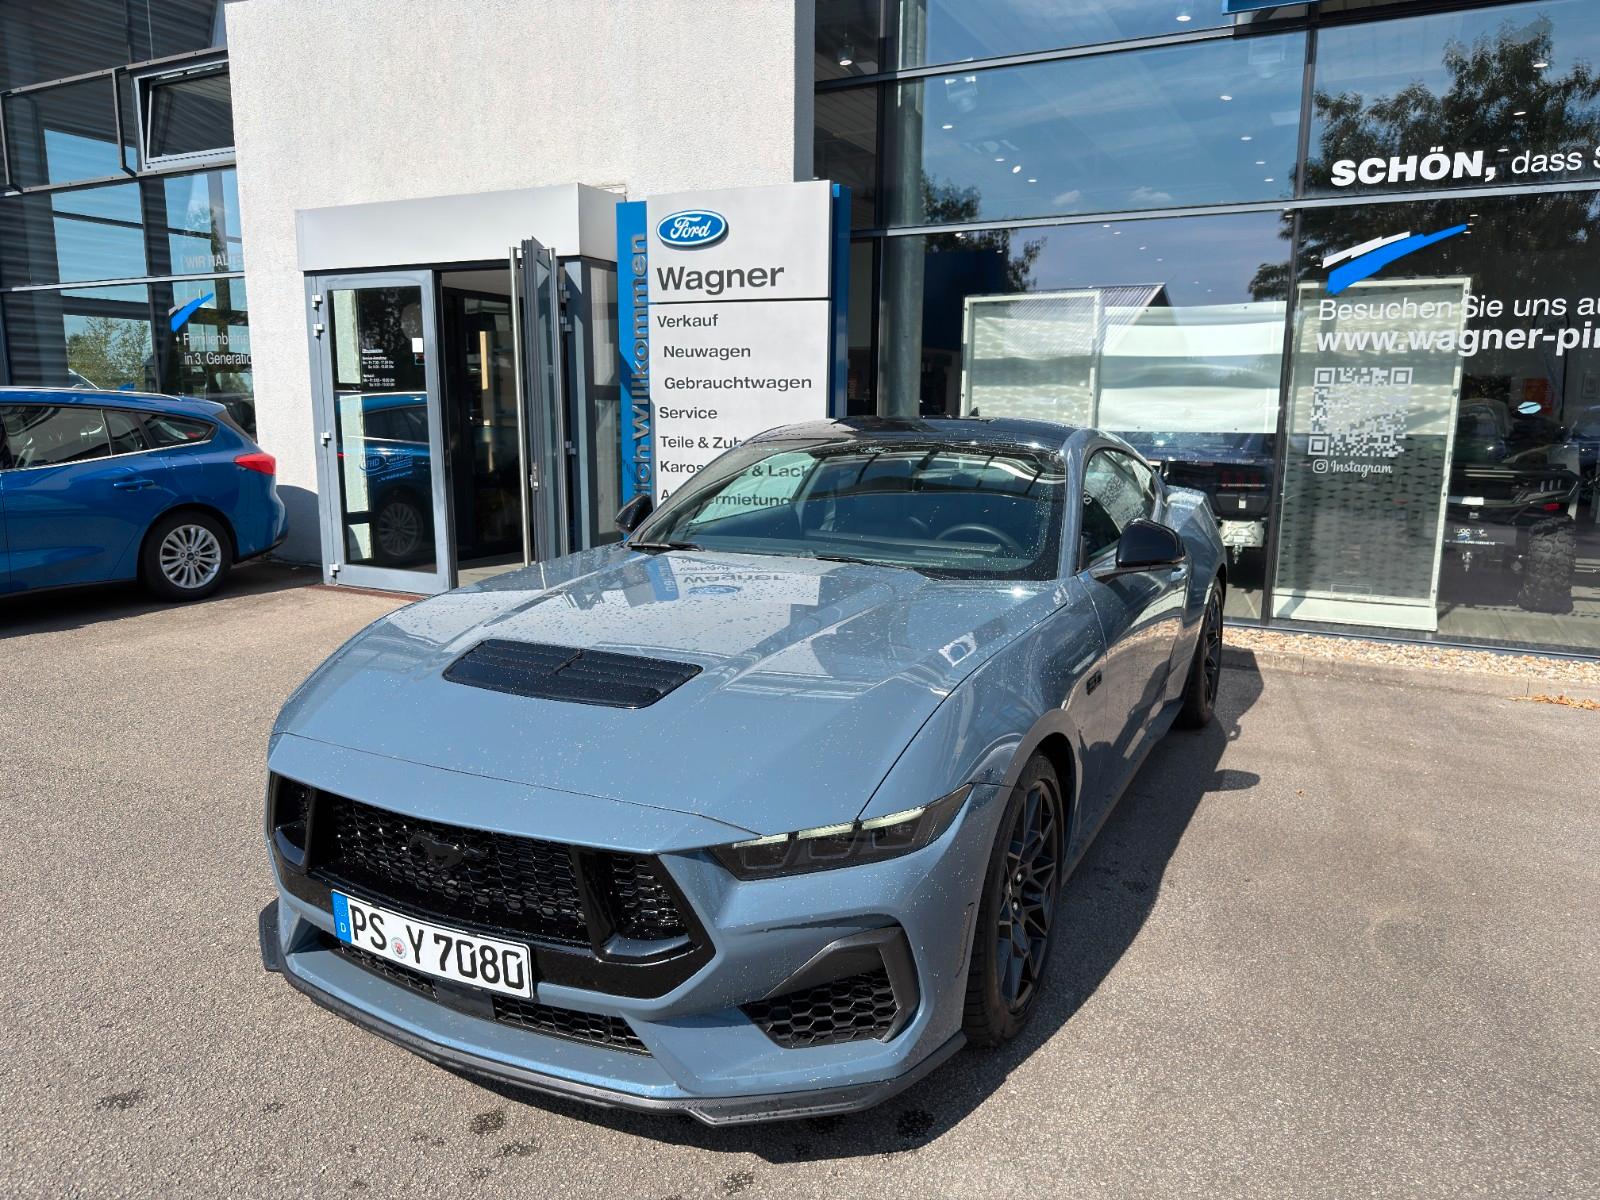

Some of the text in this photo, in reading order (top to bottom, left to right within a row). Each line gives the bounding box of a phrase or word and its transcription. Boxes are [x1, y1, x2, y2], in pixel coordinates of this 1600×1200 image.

[1331, 146, 1496, 186] SCHÖN,
[1511, 150, 1583, 174] dass
[669, 216, 712, 239] Ford
[656, 266, 785, 296] Wagner
[1318, 297, 1452, 321] Besuchen
[1460, 294, 1504, 319] Sie
[1513, 297, 1567, 318] uns
[656, 314, 719, 329] Verkauf
[631, 234, 649, 440] Willkommen
[184, 352, 193, 366] in
[194, 352, 204, 366] 3.
[662, 345, 752, 361] Neuwagen
[664, 376, 813, 392] Gebrauchtwagen
[659, 406, 719, 420] Service
[660, 436, 694, 449] Teile
[697, 437, 710, 449] &
[752, 465, 764, 477] &
[1330, 460, 1393, 479] Instagram
[340, 922, 347, 933] D
[350, 905, 525, 990] PS Y 7080
